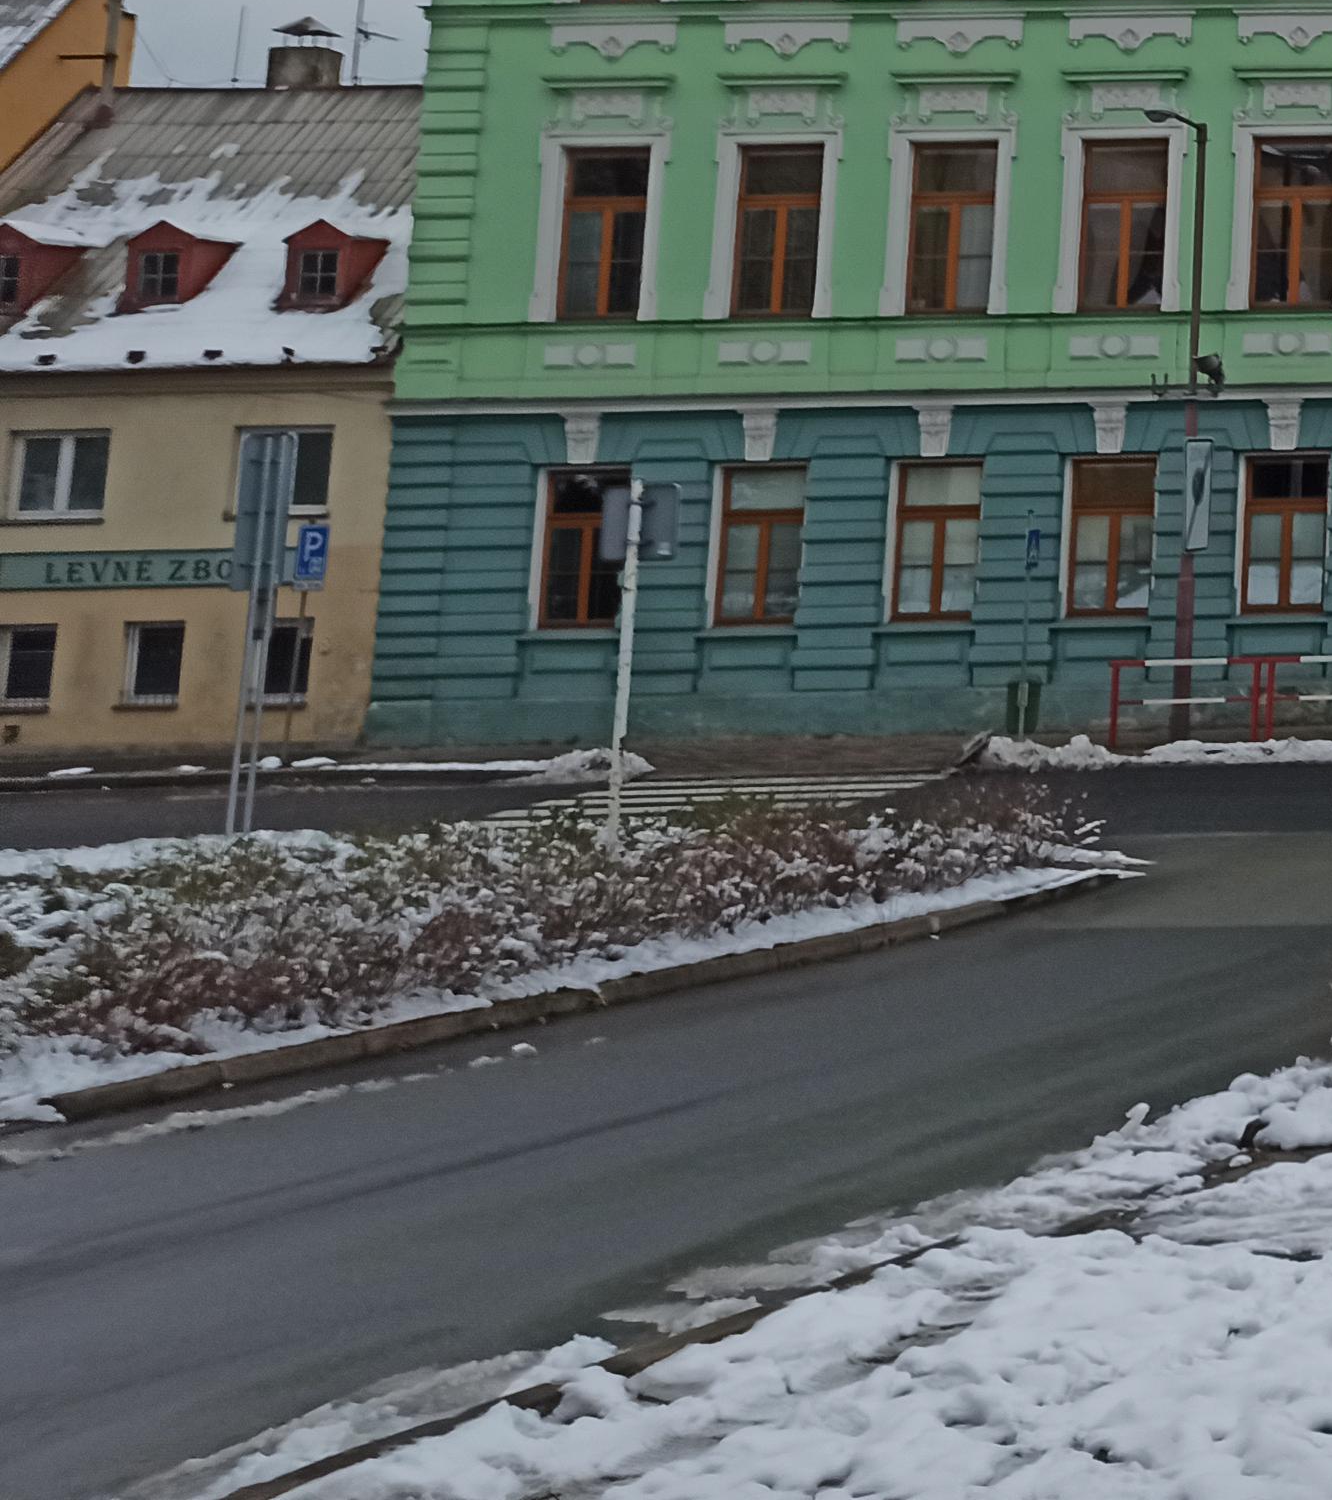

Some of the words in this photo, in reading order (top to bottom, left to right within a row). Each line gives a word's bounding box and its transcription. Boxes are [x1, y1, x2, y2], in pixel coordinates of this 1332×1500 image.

[303, 531, 323, 562] P
[45, 555, 153, 584] LEVNÉ
[167, 559, 233, 581] ZBO
